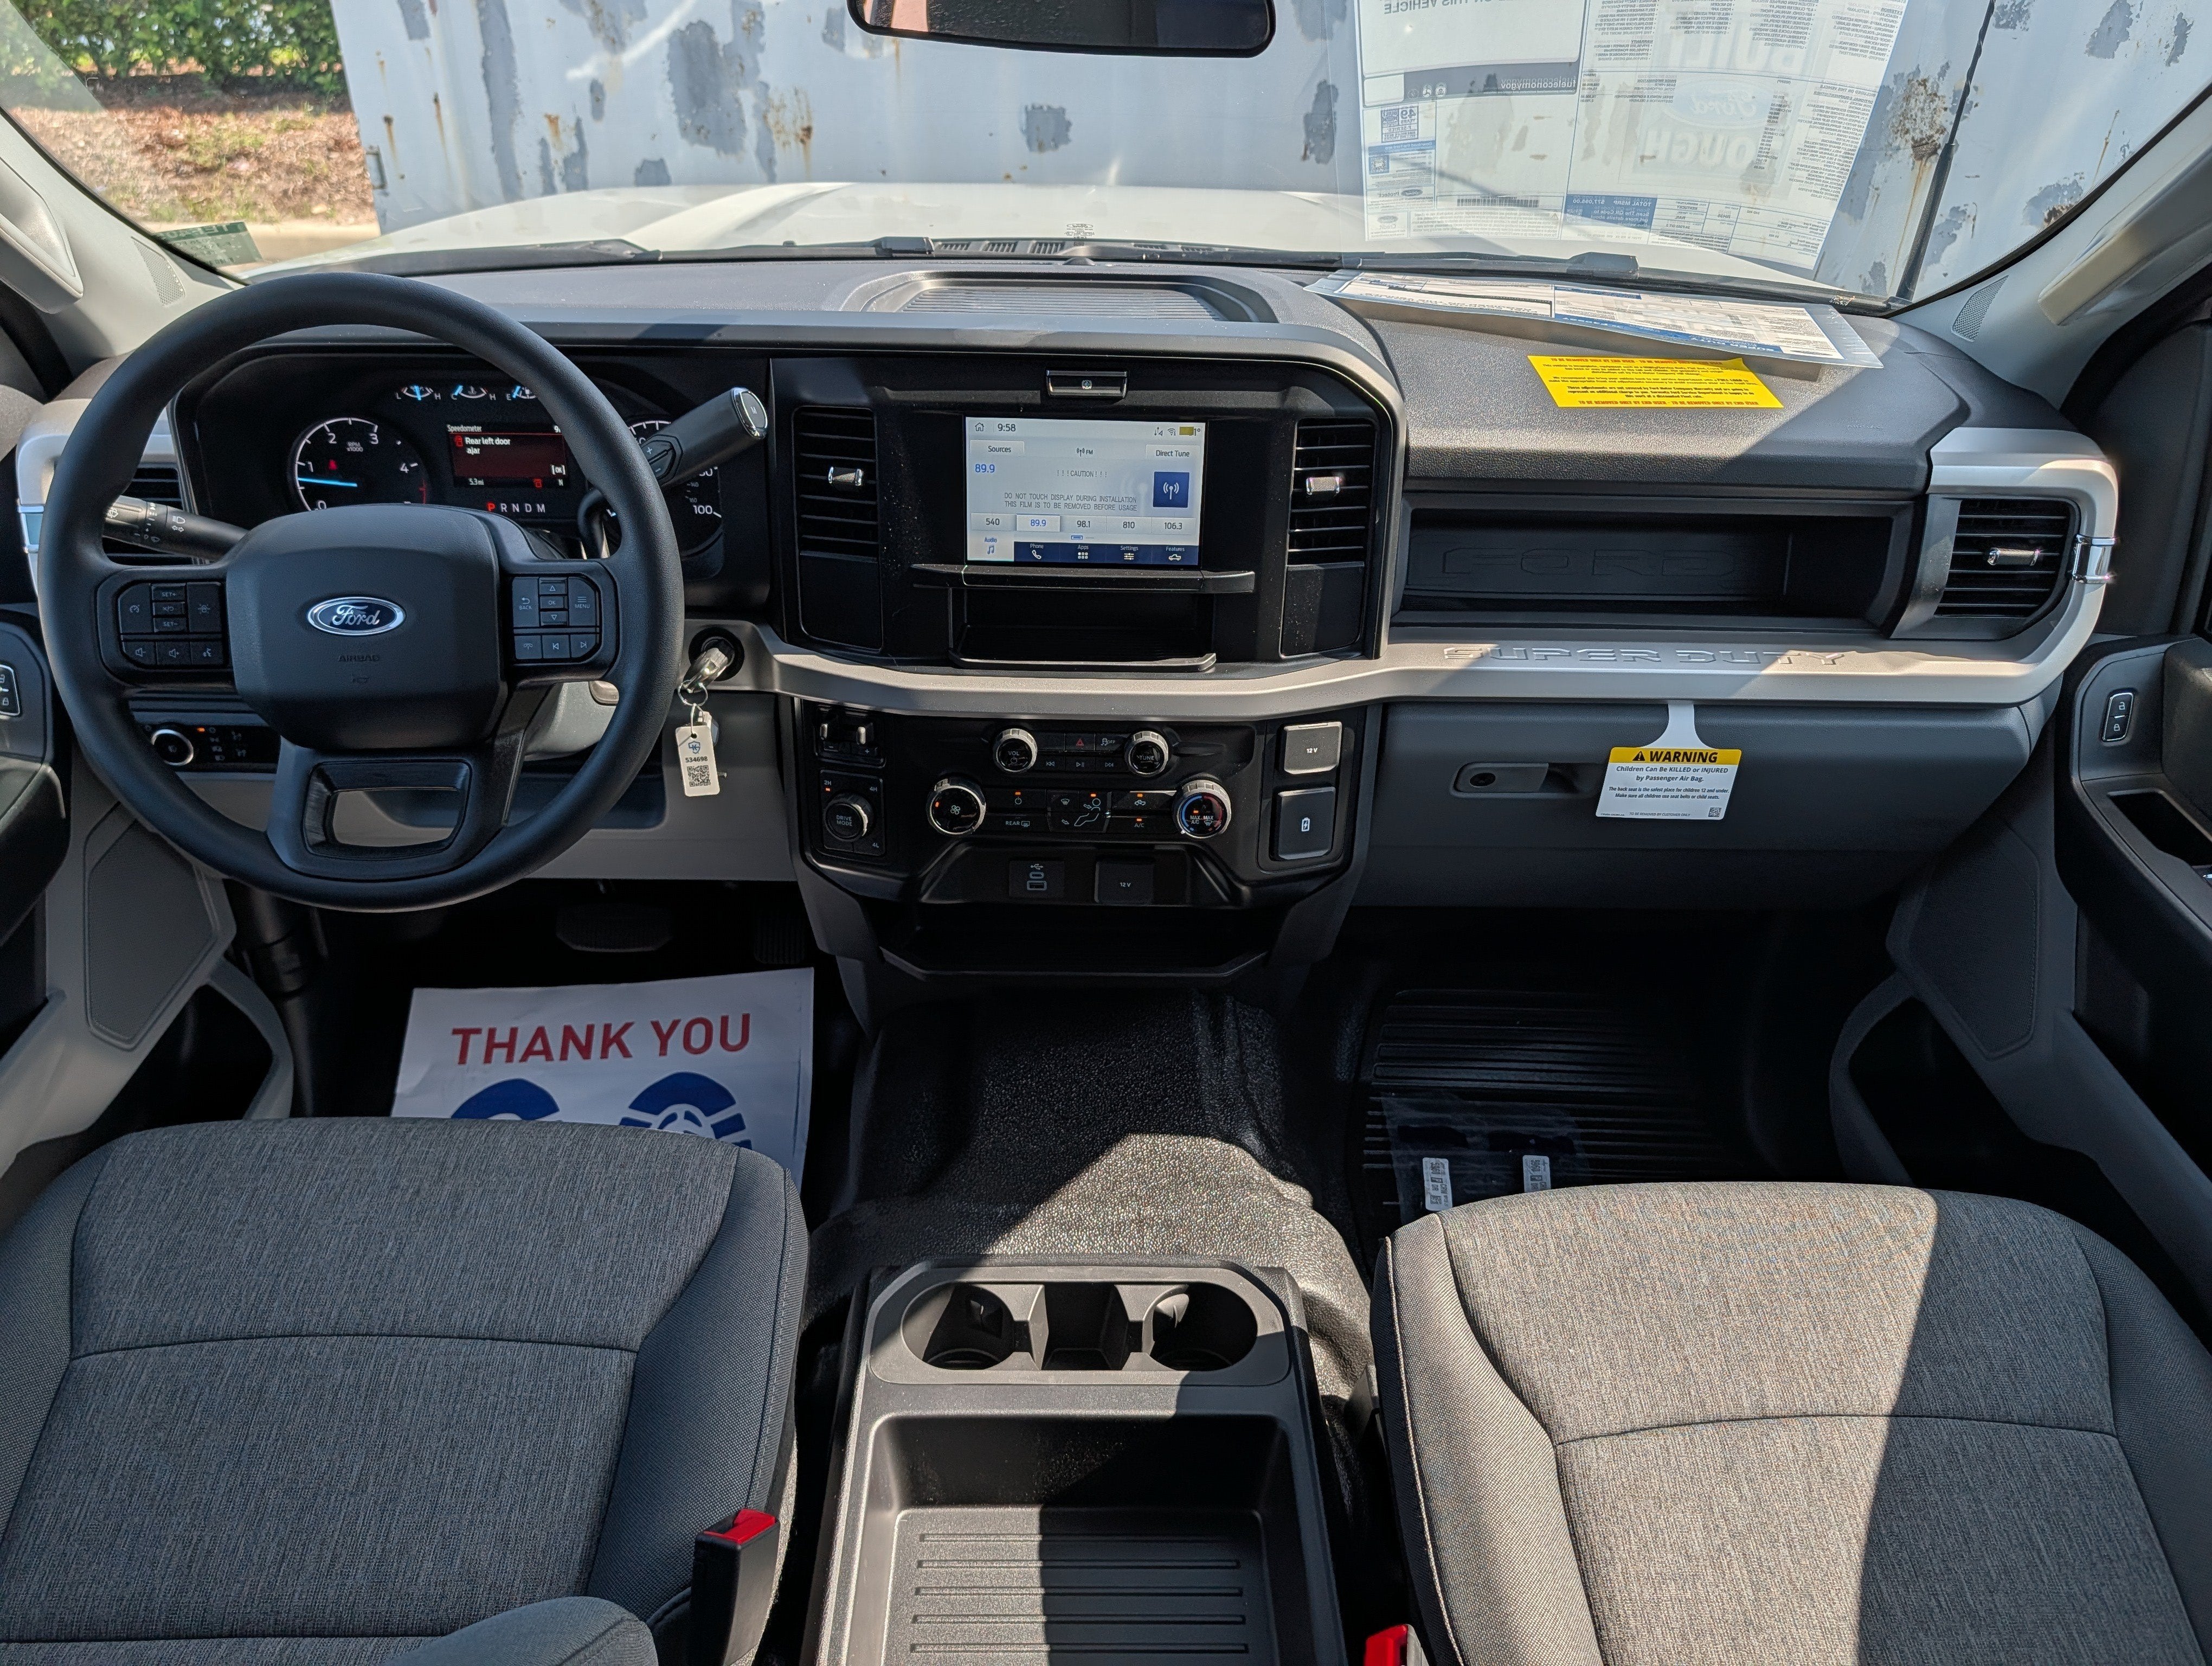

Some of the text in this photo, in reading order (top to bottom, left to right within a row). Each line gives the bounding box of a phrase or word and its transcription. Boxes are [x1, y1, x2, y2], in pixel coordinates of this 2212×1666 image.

[447, 424, 482, 433] Speedometer
[998, 424, 1016, 432] 9:58
[328, 433, 337, 444] 2
[369, 433, 378, 445] 3
[465, 437, 511, 445] Rear left door
[466, 446, 480, 456] ajar
[307, 461, 313, 472] 1
[400, 463, 409, 473] 4
[975, 464, 995, 473] 89.9
[487, 501, 545, 513] P R N D M
[693, 505, 713, 515] 100
[986, 518, 1000, 526] 540
[1030, 519, 1046, 527] 89.9
[1077, 520, 1091, 528] 98.1
[1164, 522, 1182, 530] 106.3
[331, 604, 381, 626] Ford
[1443, 646, 1846, 666] SUPER DUTY
[1649, 751, 1719, 763] WARNING
[452, 1013, 750, 1065] THANK YOU
